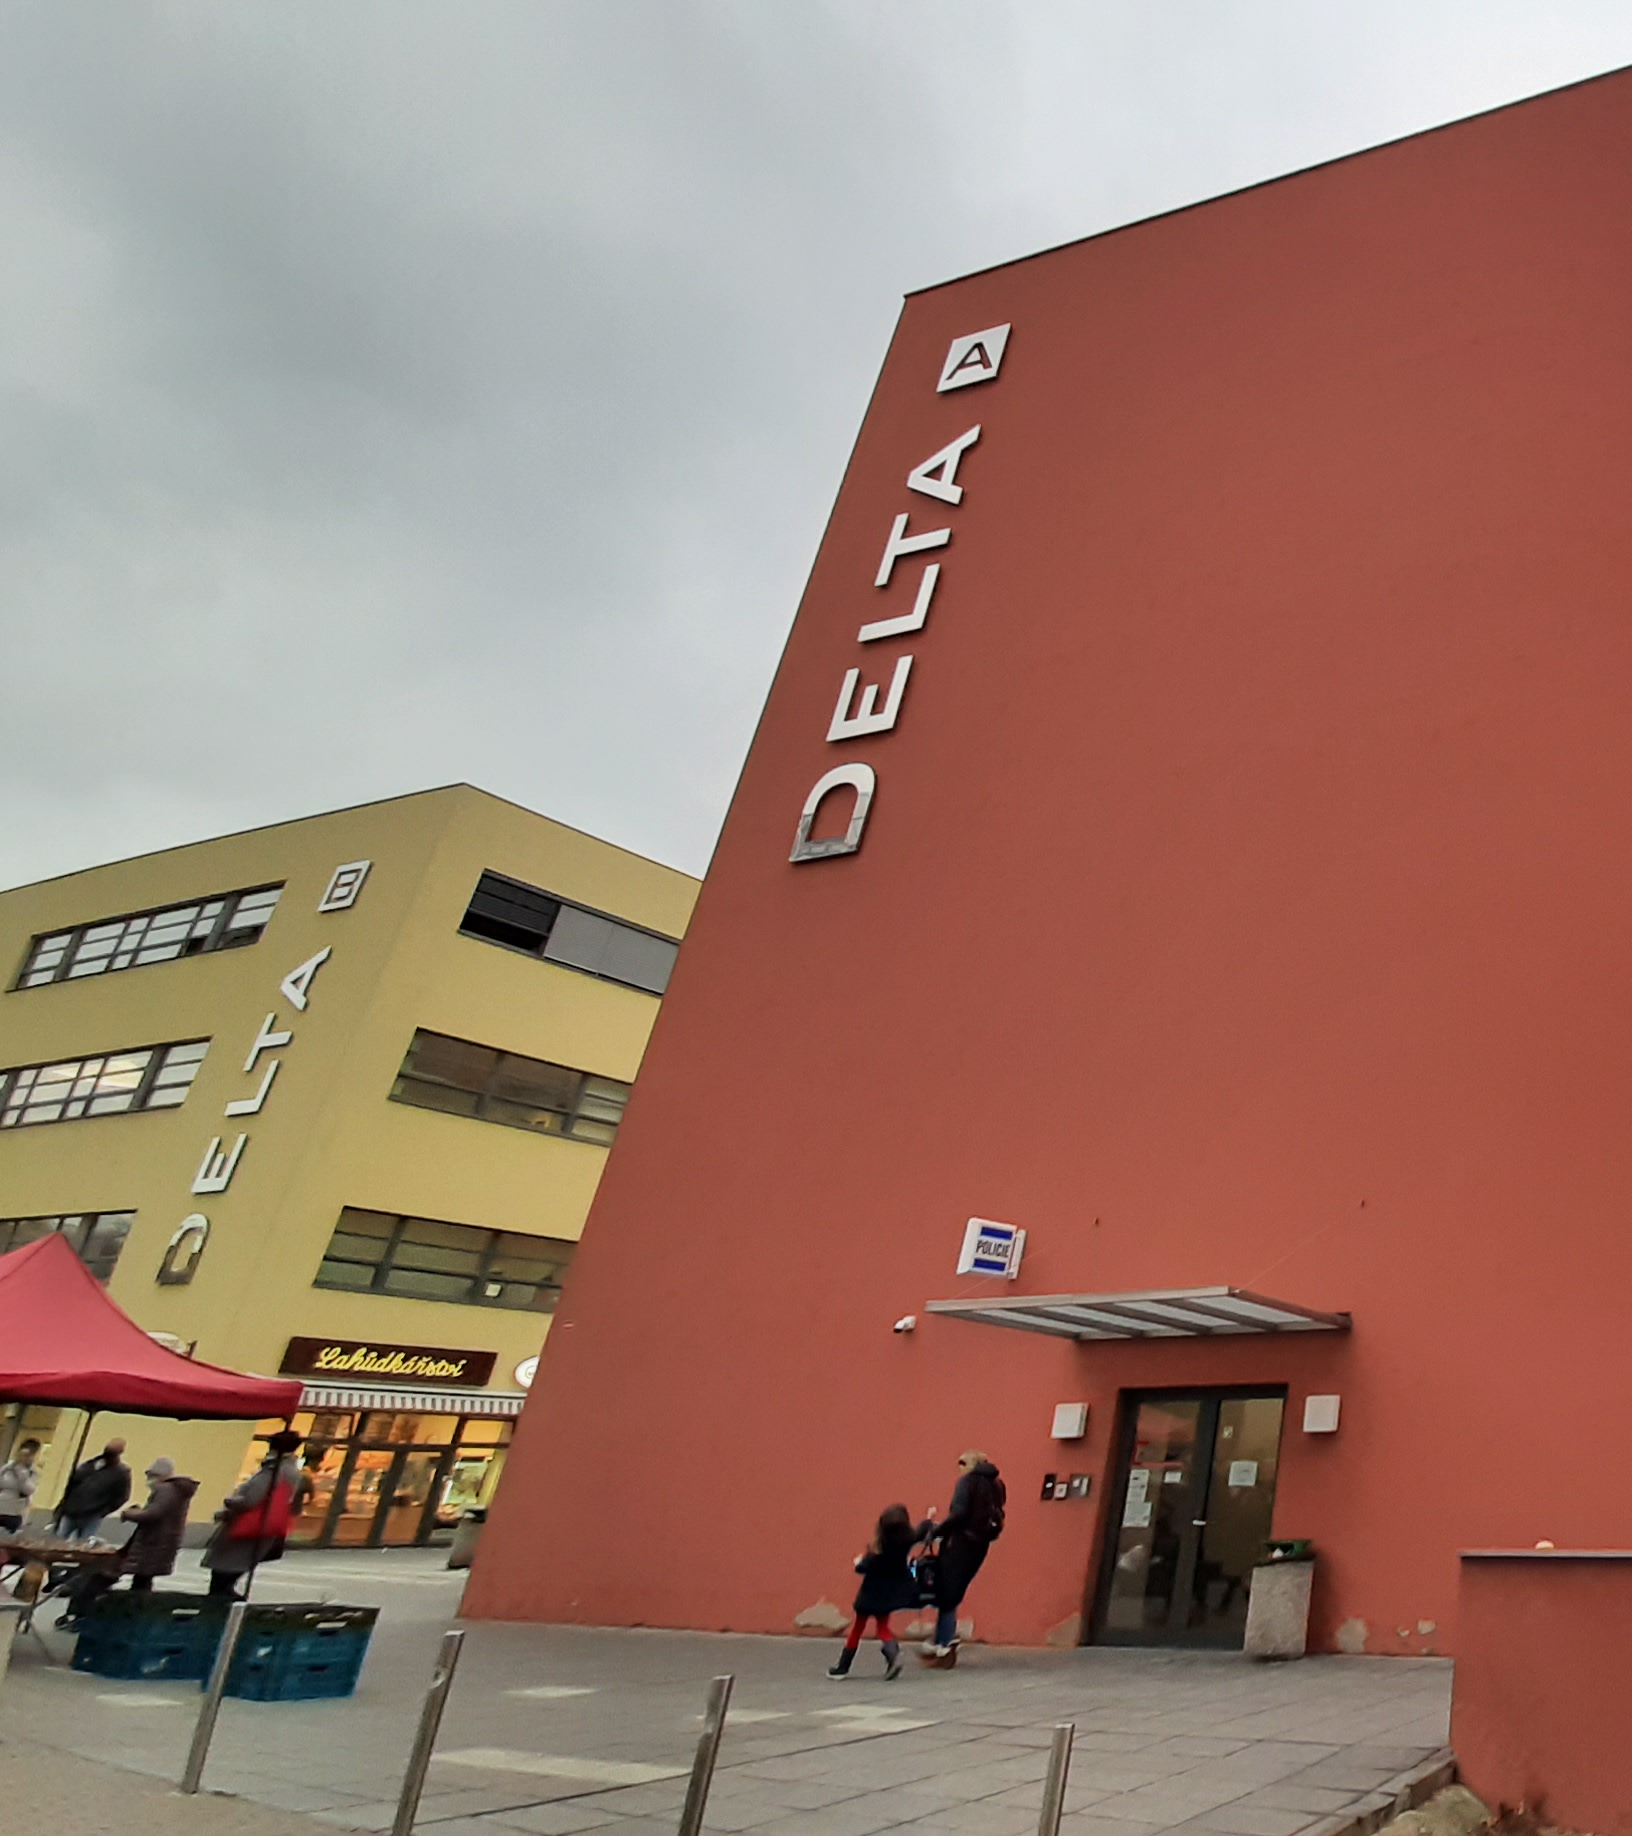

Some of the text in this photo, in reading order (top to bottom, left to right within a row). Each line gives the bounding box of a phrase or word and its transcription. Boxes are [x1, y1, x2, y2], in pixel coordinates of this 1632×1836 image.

[788, 424, 981, 862] DELTA
[154, 945, 332, 1286] DELTA
[975, 1240, 1010, 1257] POLICIE
